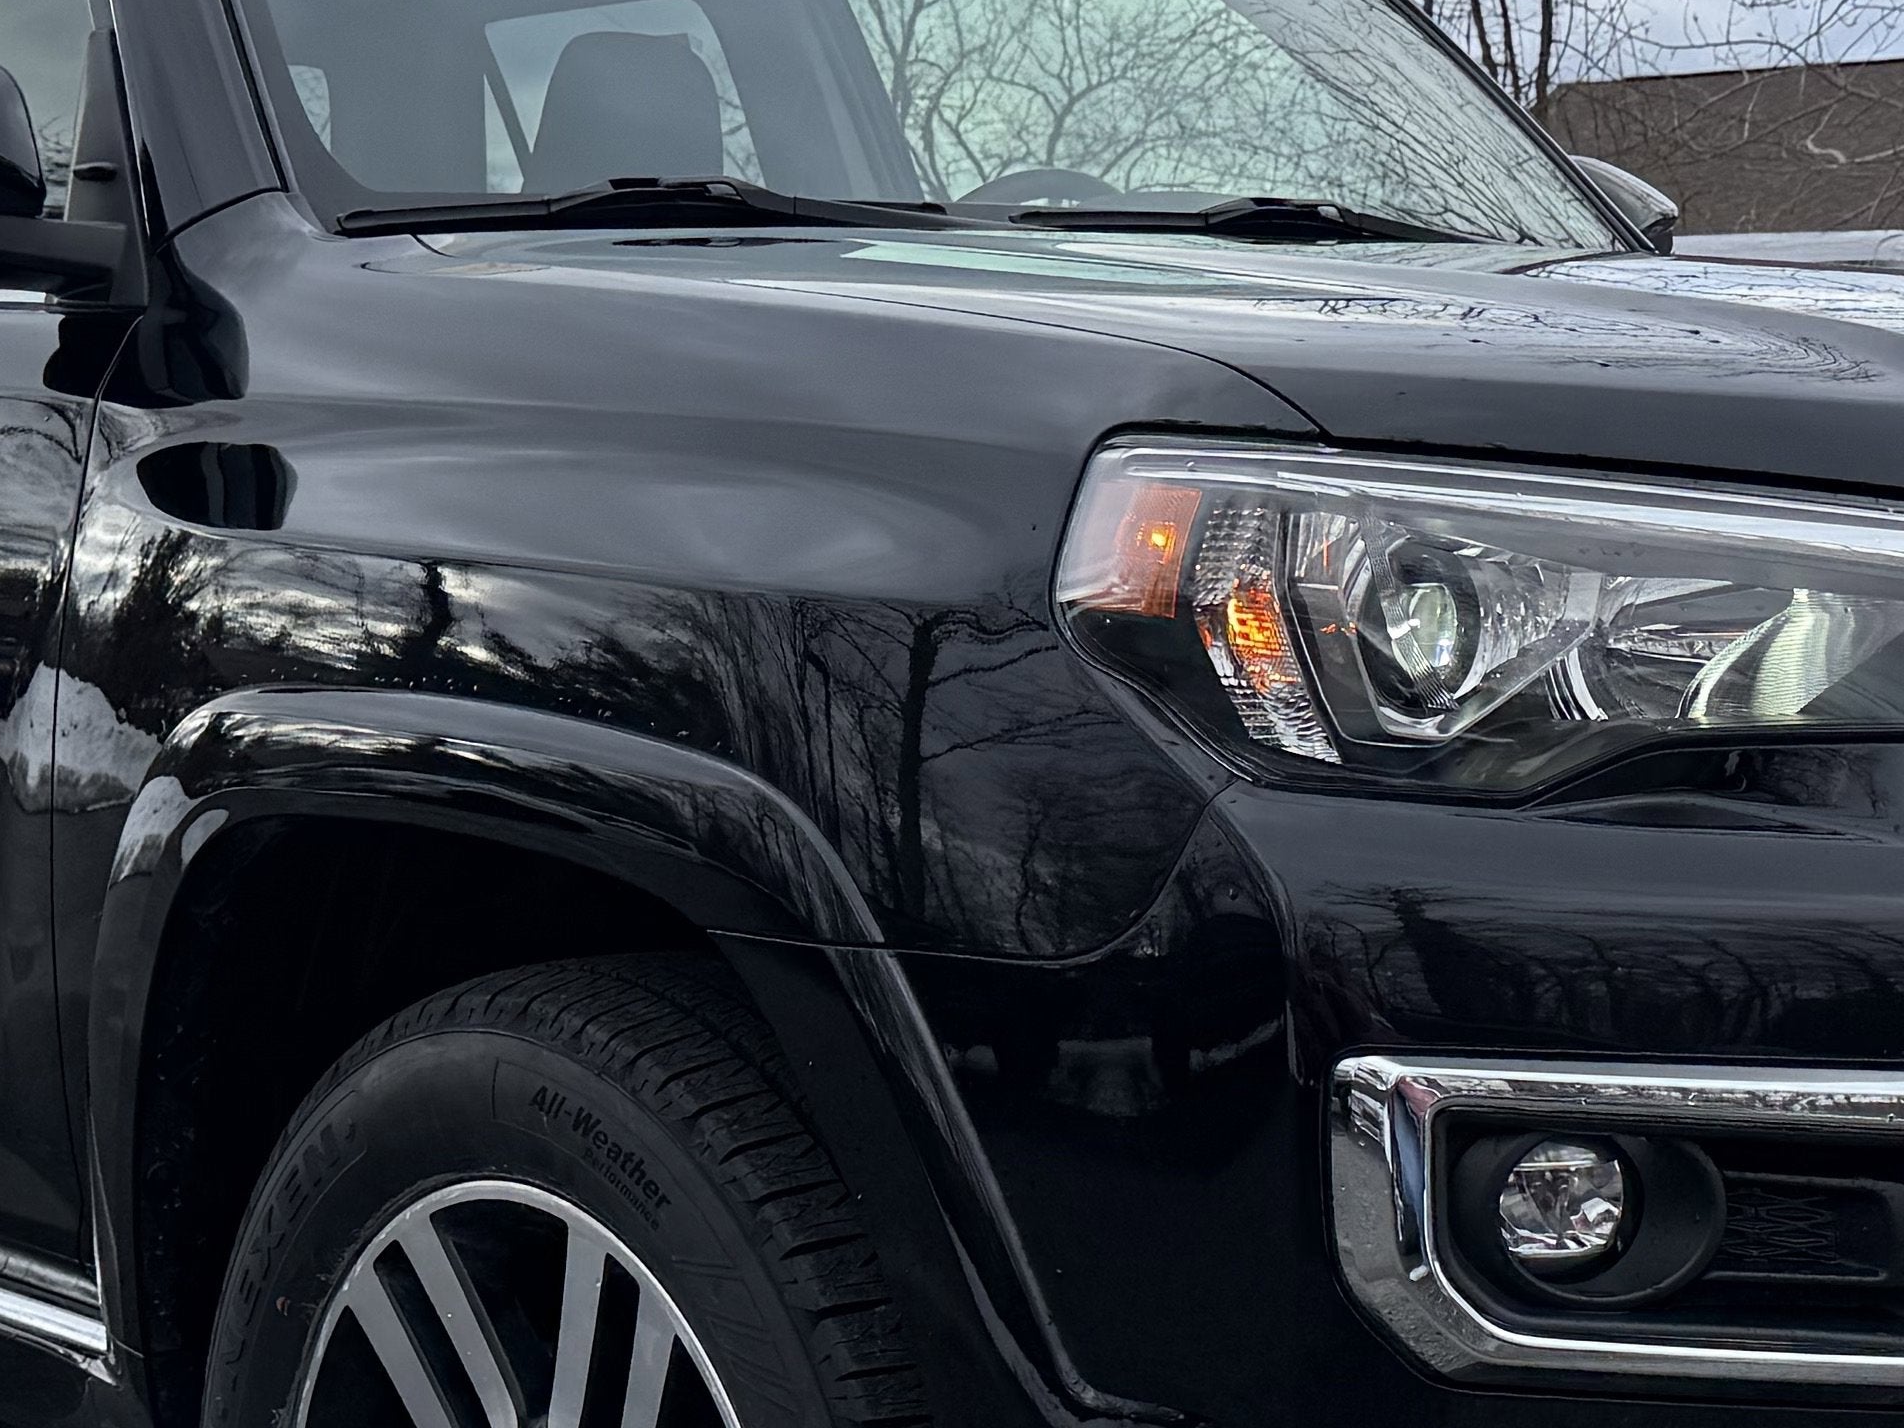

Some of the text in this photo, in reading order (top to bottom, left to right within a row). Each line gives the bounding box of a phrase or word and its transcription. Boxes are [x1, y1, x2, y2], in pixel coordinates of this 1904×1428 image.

[529, 1085, 672, 1214] All-Weather
[584, 1146, 660, 1232] Performance
[216, 1117, 340, 1392] NEXEN
